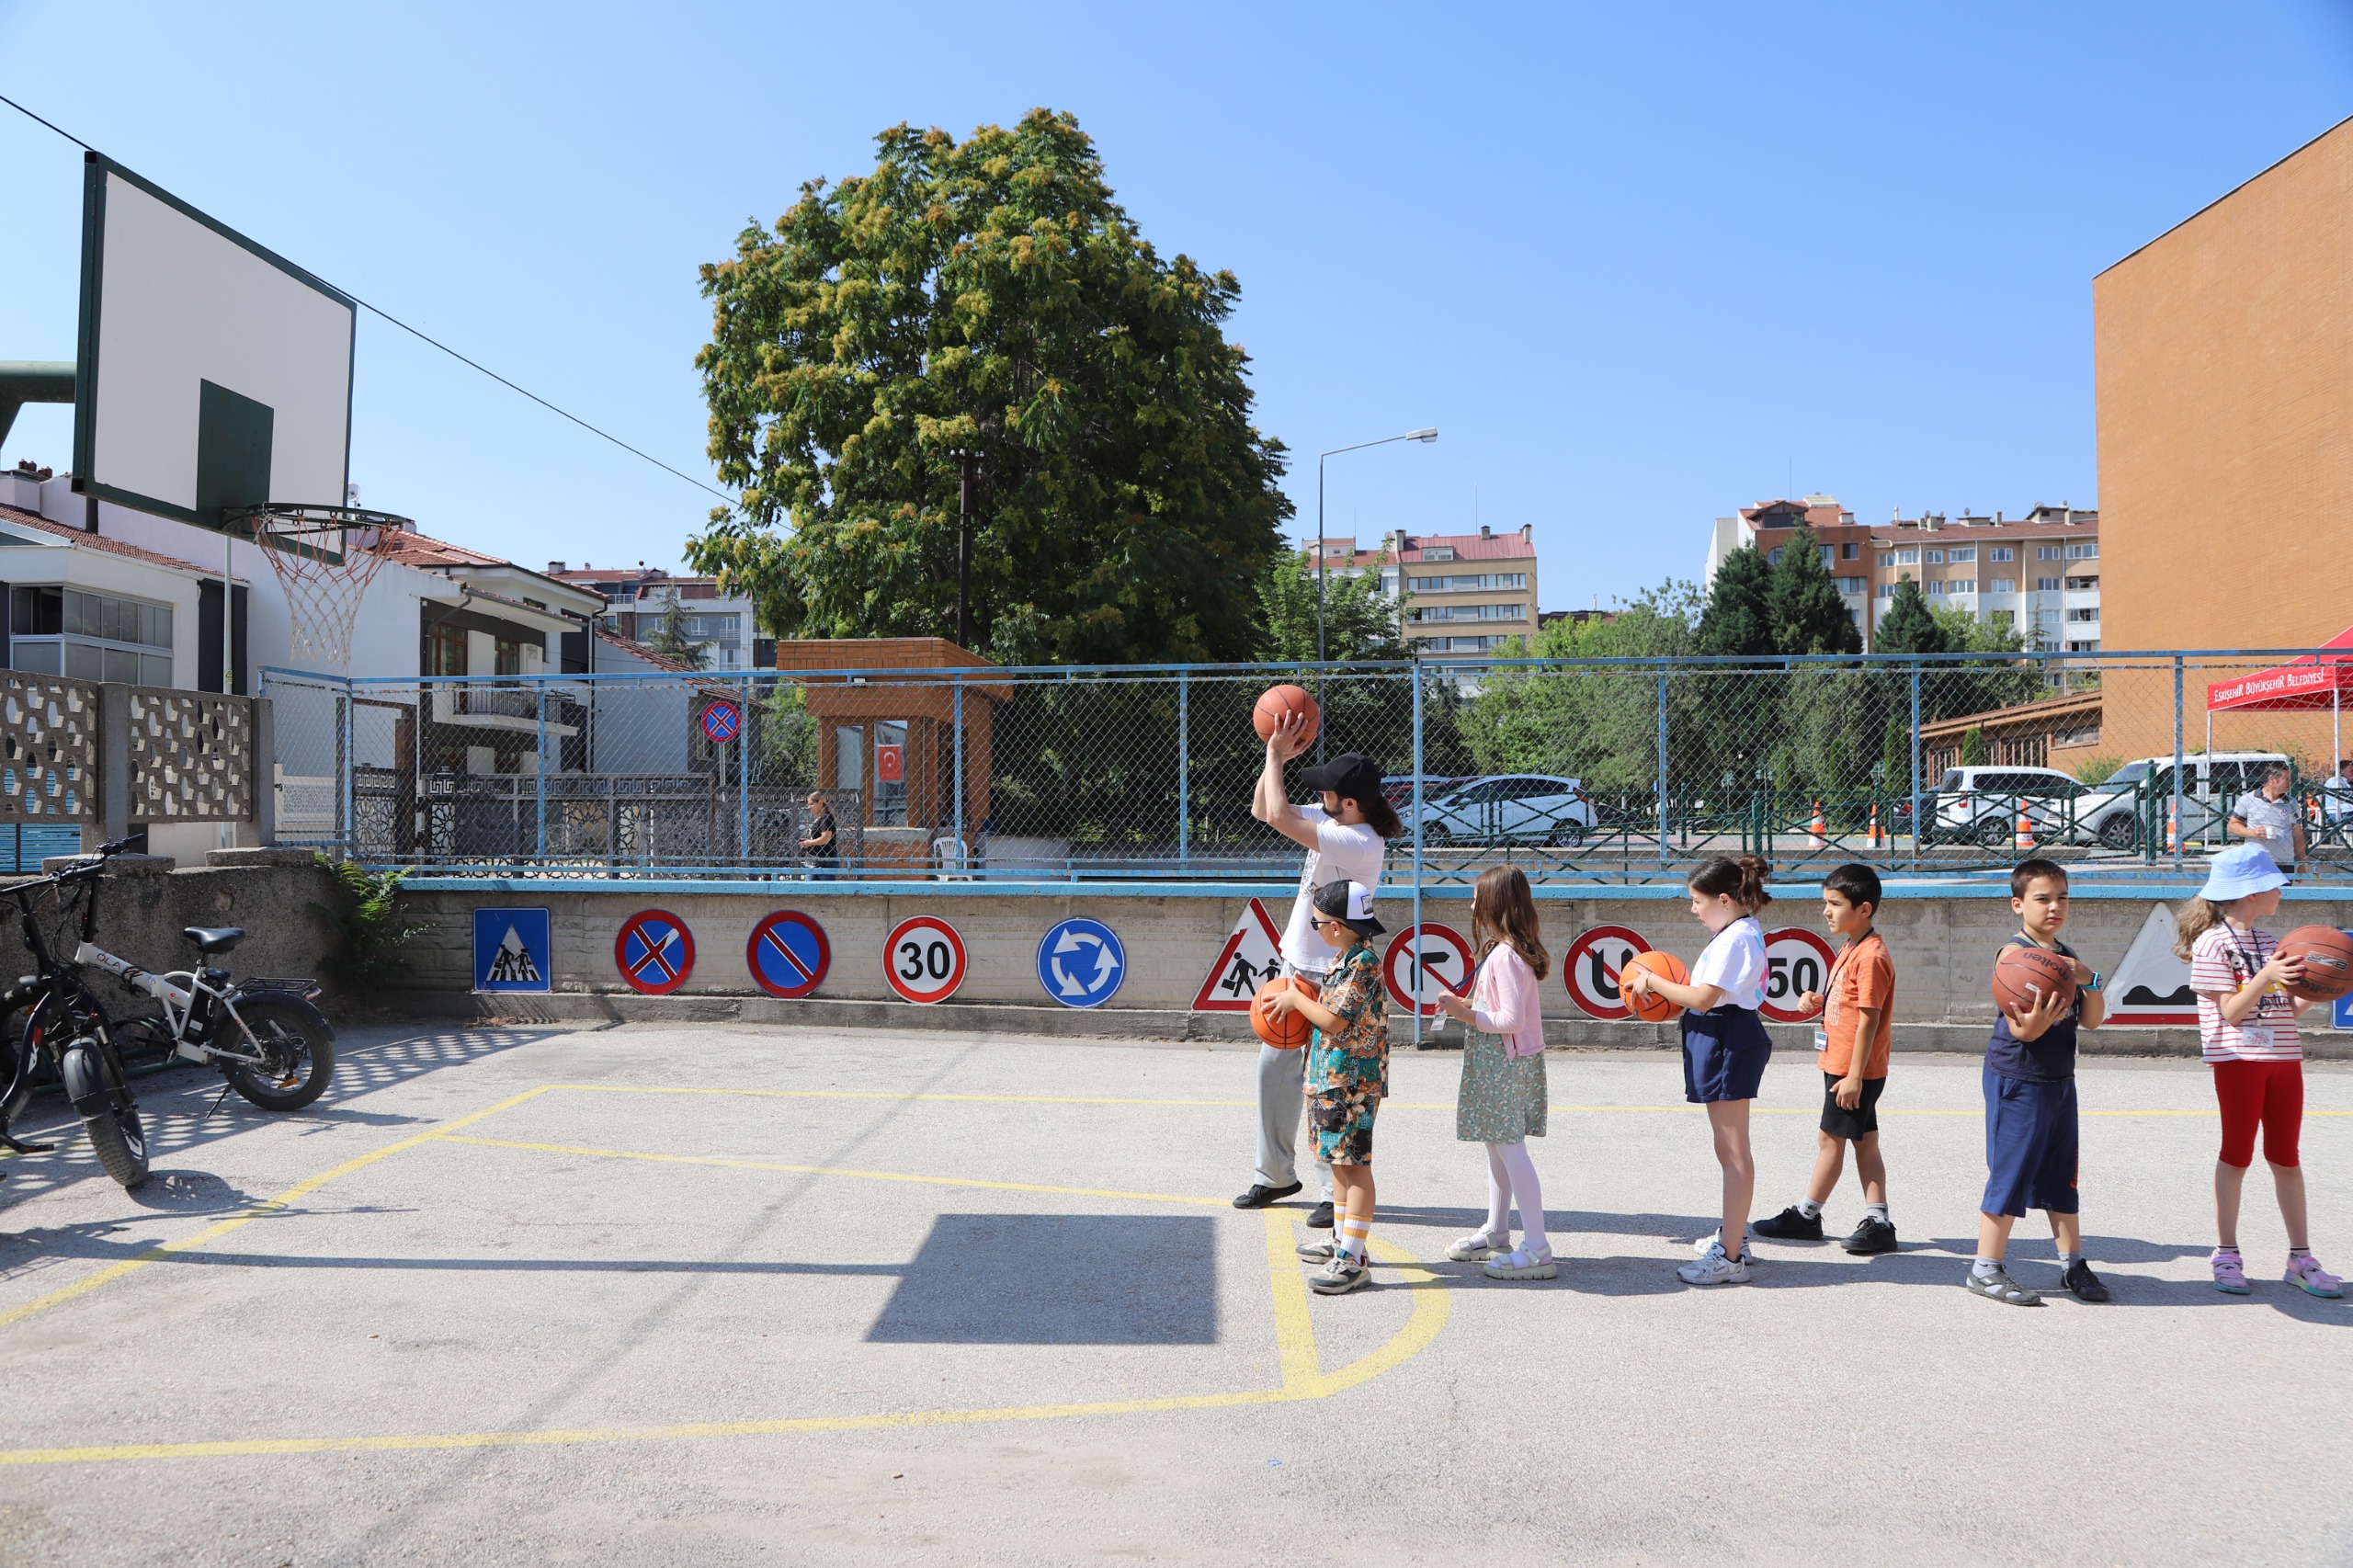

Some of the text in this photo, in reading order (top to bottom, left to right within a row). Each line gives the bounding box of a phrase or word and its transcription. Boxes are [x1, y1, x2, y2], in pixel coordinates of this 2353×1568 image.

[900, 941, 950, 981] 30
[1766, 958, 1819, 999] 50
[2023, 951, 2070, 982] molten
[2299, 978, 2346, 994] molte
